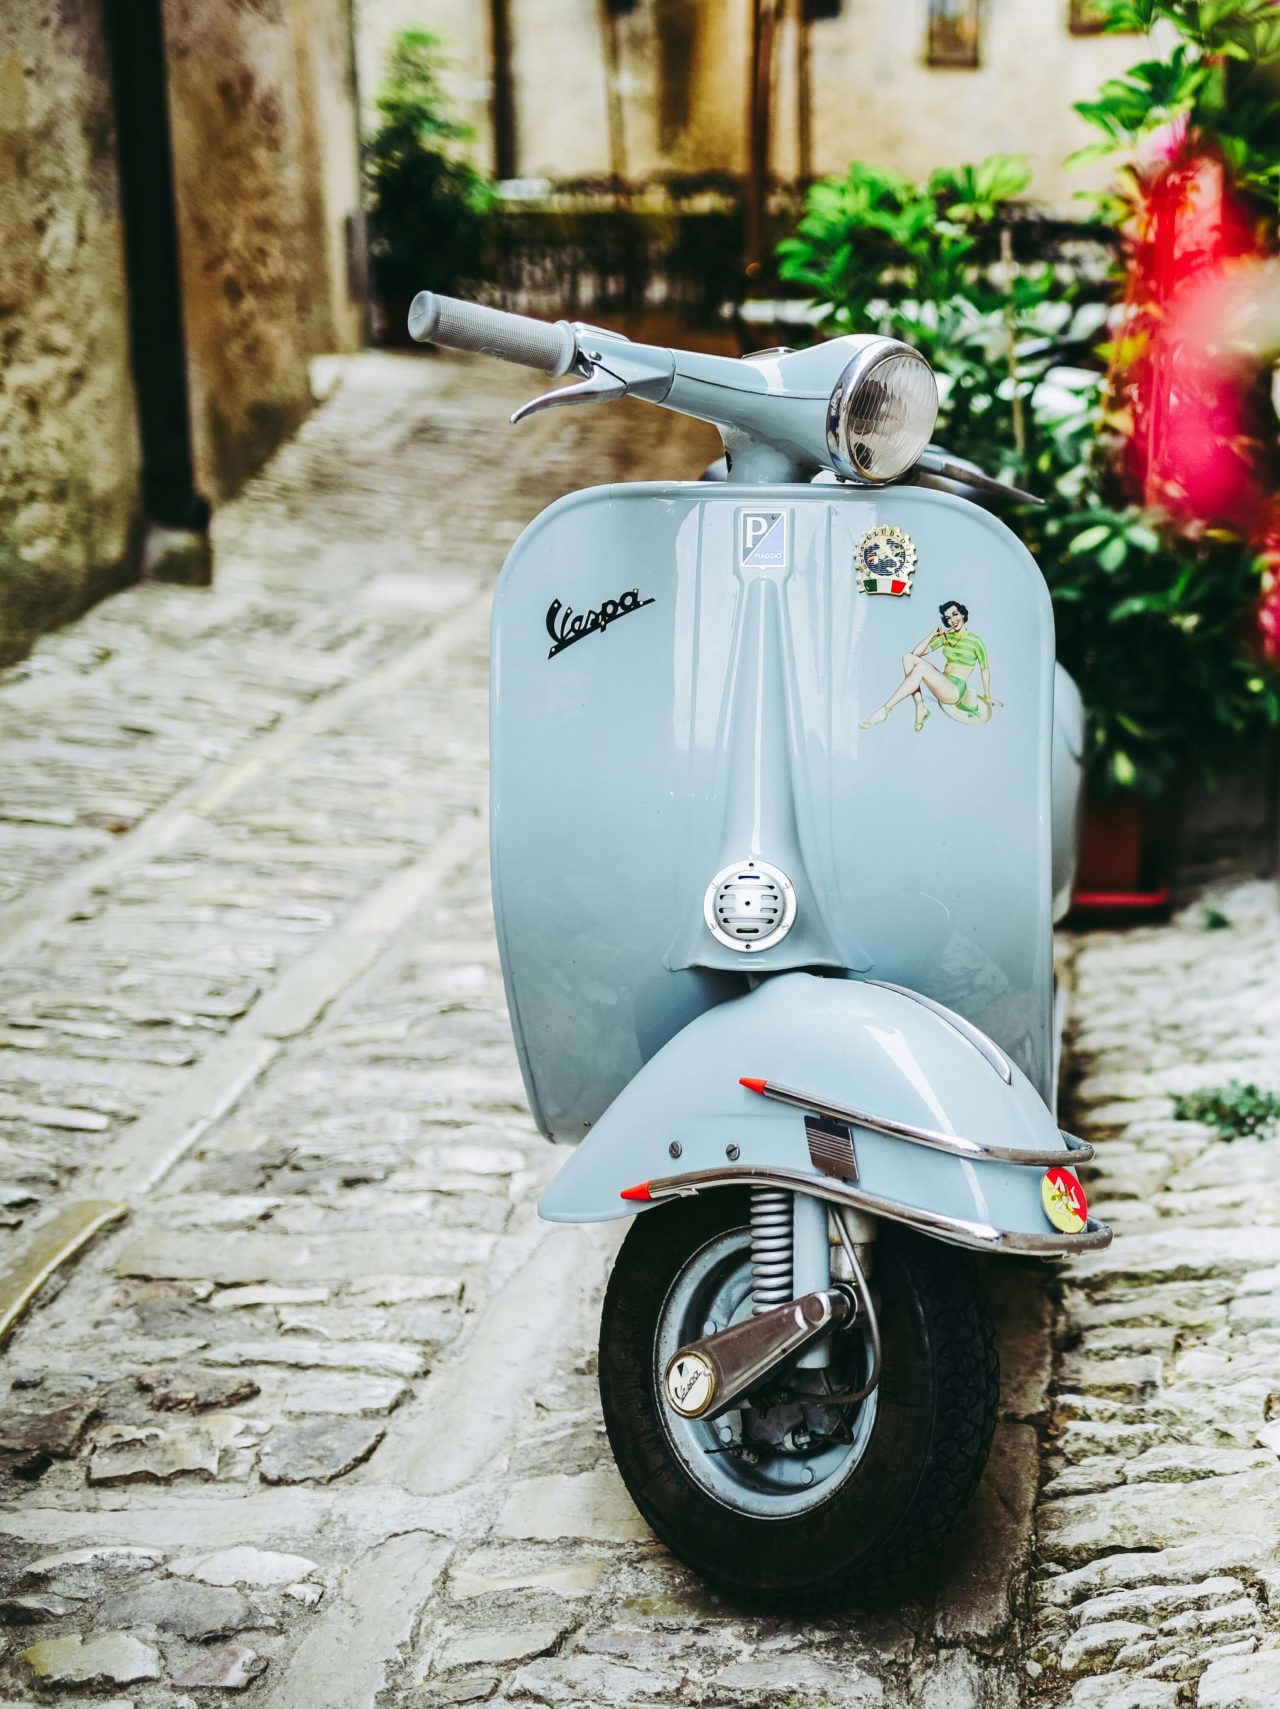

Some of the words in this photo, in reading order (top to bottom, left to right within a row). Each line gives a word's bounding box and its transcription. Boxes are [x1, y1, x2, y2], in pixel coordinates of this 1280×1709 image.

[745, 516, 768, 548] P
[866, 529, 895, 540] CLUB
[546, 588, 656, 660] Vespa
[674, 1370, 703, 1406] Vespa
